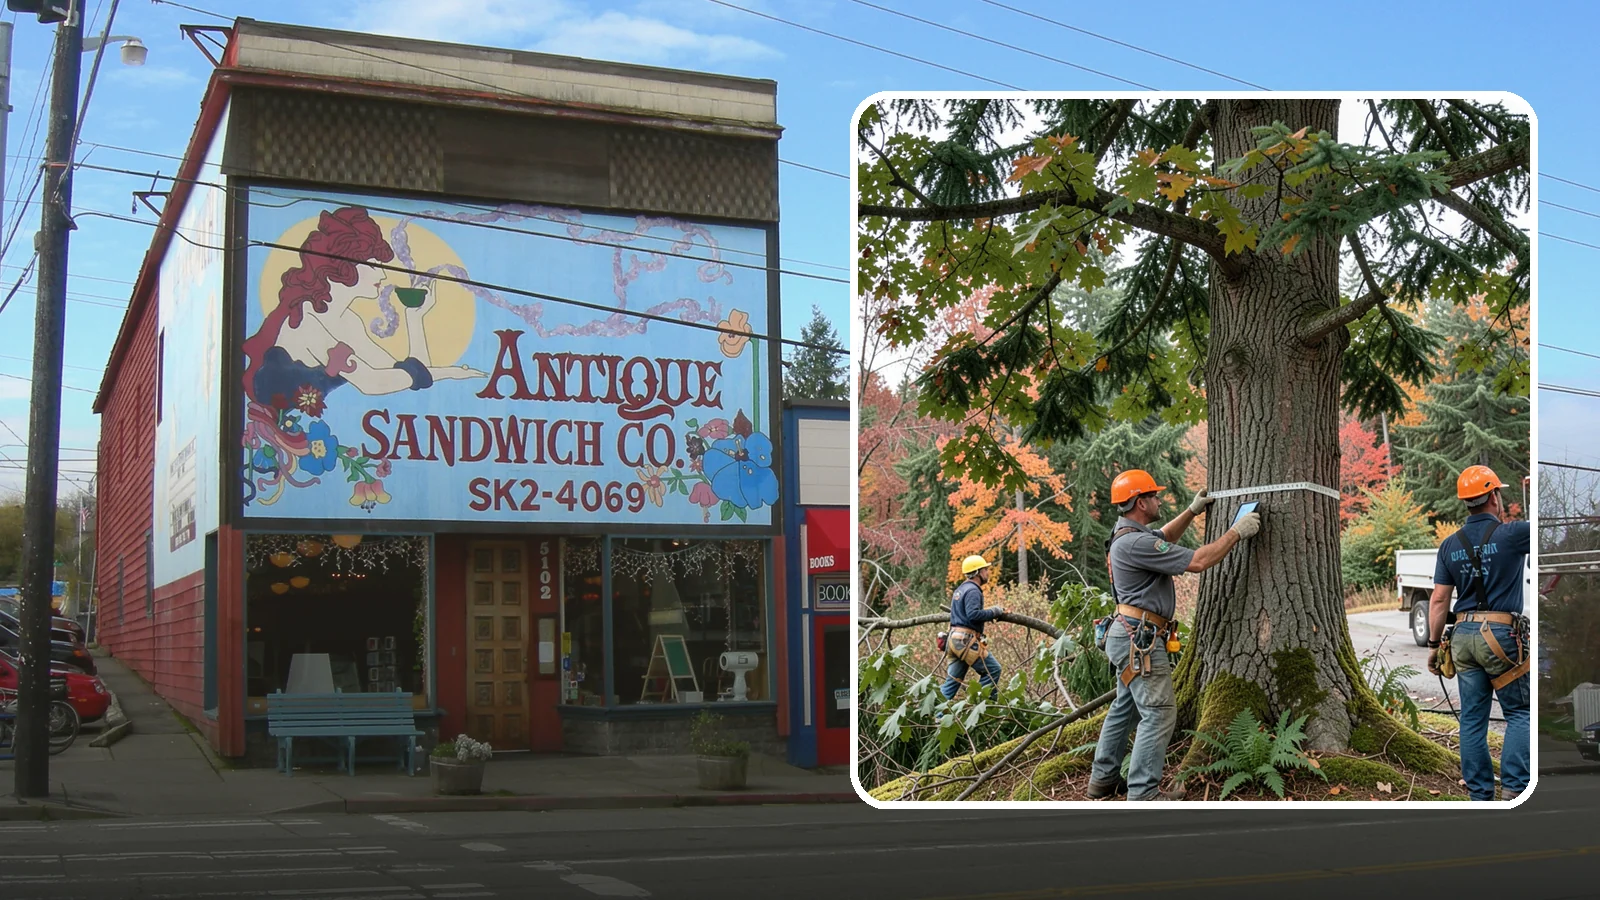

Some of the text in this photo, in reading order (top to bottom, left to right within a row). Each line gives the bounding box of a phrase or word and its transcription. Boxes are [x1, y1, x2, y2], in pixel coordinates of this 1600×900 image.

[476, 329, 723, 420] ANTIQUE
[361, 408, 685, 468] SANDWICH CO.
[468, 477, 646, 512] SK2-4069
[539, 541, 552, 600] 5102
[809, 555, 835, 569] BOOKS
